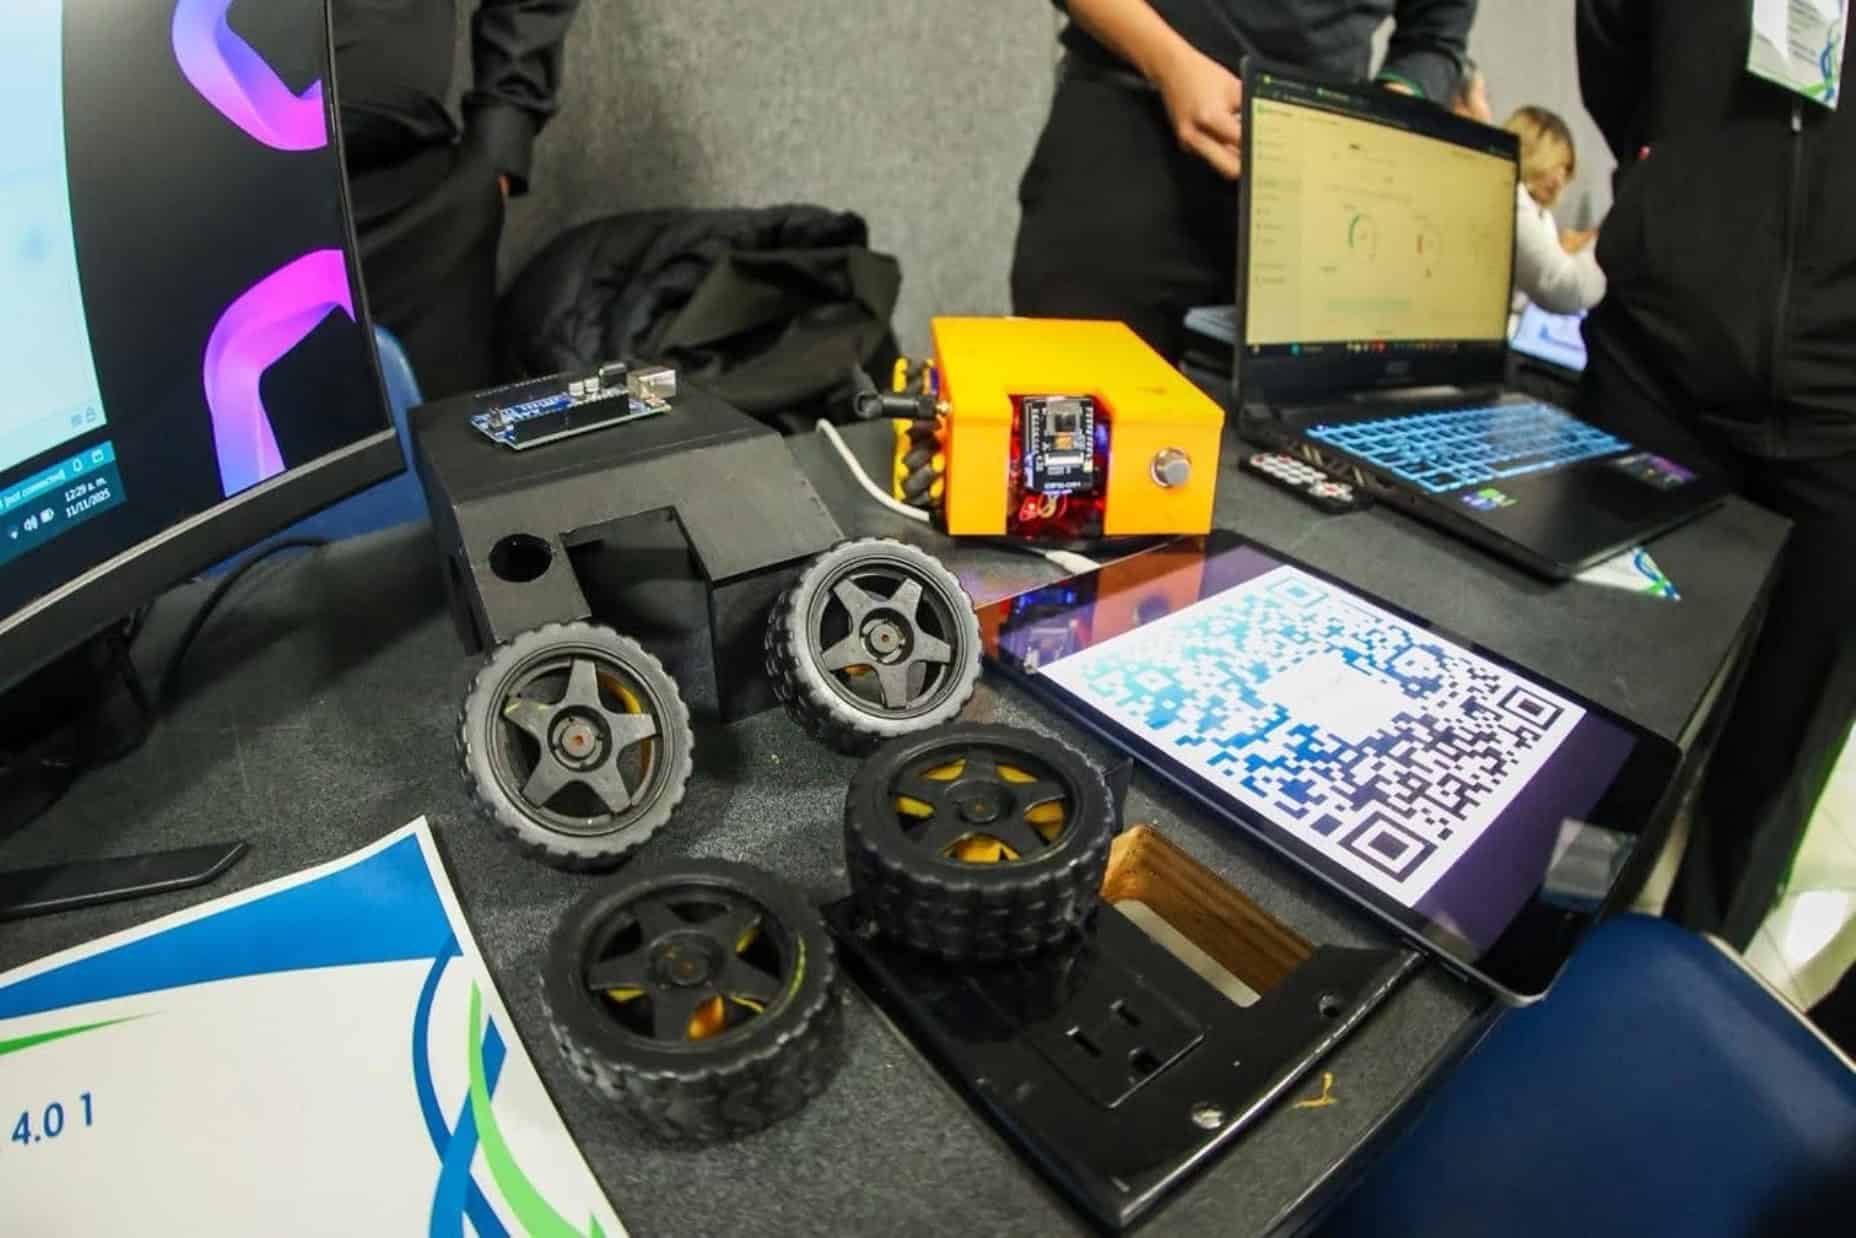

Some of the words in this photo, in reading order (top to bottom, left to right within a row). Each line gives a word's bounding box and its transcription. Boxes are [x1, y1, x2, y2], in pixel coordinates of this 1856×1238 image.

[65, 487, 111, 519] 11/11/2025
[11, 1101, 65, 1146] 4.0
[79, 1091, 93, 1127] 1
